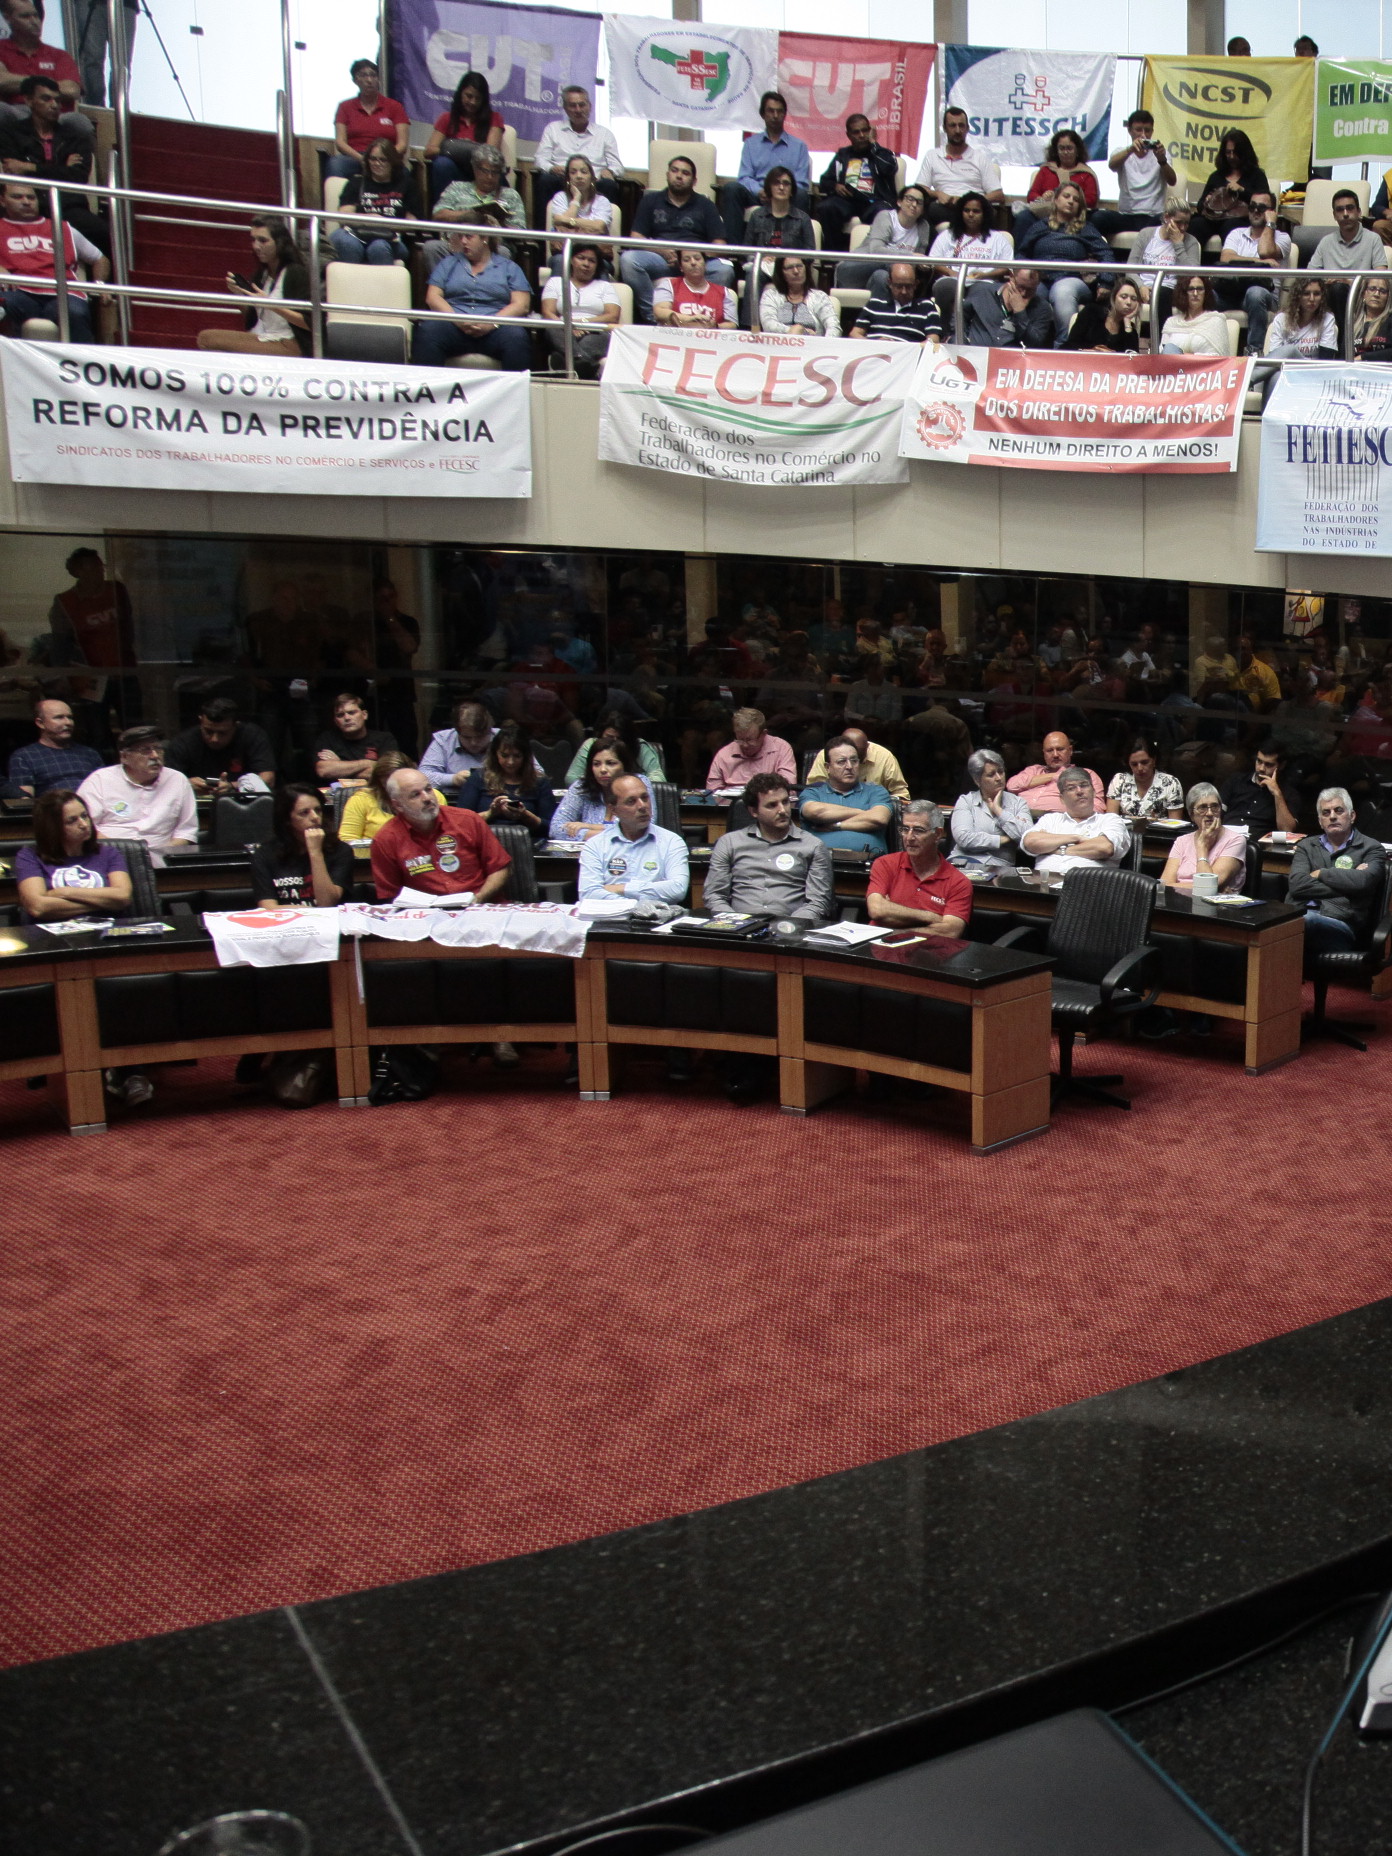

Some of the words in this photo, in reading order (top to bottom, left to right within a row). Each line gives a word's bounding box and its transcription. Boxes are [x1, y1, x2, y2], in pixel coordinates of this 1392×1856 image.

[888, 57, 908, 123] BRASIL
[1179, 81, 1255, 104] NCST
[1329, 83, 1355, 106] EM
[1333, 117, 1389, 137] Contra
[1168, 142, 1220, 163] CENT
[695, 330, 720, 340] CUT
[738, 333, 805, 347] CONTRACS
[59, 359, 187, 393] SOMOS
[201, 372, 289, 399] 100%
[303, 378, 437, 404] CONTRA
[446, 382, 469, 404] A
[642, 342, 892, 408] FECESC
[929, 373, 977, 391] UGT
[996, 368, 1018, 389] EM
[1026, 369, 1082, 392] DEFESA
[1090, 371, 1111, 394] DA
[1115, 368, 1223, 394] PREVIDÊNCIA
[1227, 369, 1238, 388] E
[32, 398, 209, 434] REFORMA
[221, 410, 268, 436] DA
[279, 412, 495, 443] PREVIDÊNCIA
[985, 397, 1018, 419] DOS
[1022, 401, 1097, 424] DIREITOS
[1103, 402, 1228, 425] TRABALHISTAS!
[641, 412, 721, 444] Federação
[726, 429, 756, 447] dos
[56, 445, 132, 458] SINDICATOS
[136, 449, 162, 460] DOS
[166, 450, 272, 464] TRABALHADORES
[275, 455, 292, 466] NO
[296, 455, 355, 467] COMÉRCIO
[359, 459, 366, 467] E
[370, 458, 425, 470] SERVIÇOS
[439, 459, 480, 471] FECESC
[640, 430, 750, 464] Trabalhadores
[755, 453, 776, 467] no
[782, 450, 856, 467] Comércio
[862, 451, 881, 464] no
[988, 437, 1061, 456] NENHUM
[1066, 443, 1132, 458] DIREITO
[1136, 445, 1148, 458] A
[1152, 442, 1219, 458] MENOS!
[638, 449, 691, 474] Estado
[696, 460, 716, 477] de
[721, 464, 765, 483] Santa
[771, 466, 835, 483] Catarina
[1304, 500, 1356, 513] FEDERAÇÃO
[1361, 504, 1379, 513] DOS
[1303, 526, 1320, 535] NAS
[1326, 524, 1378, 537] INDÚSTRIAS
[1304, 514, 1379, 525] TRABALHADORES
[1302, 538, 1315, 547] DO
[1322, 538, 1358, 549] ESTADO
[1365, 540, 1377, 549] DE
